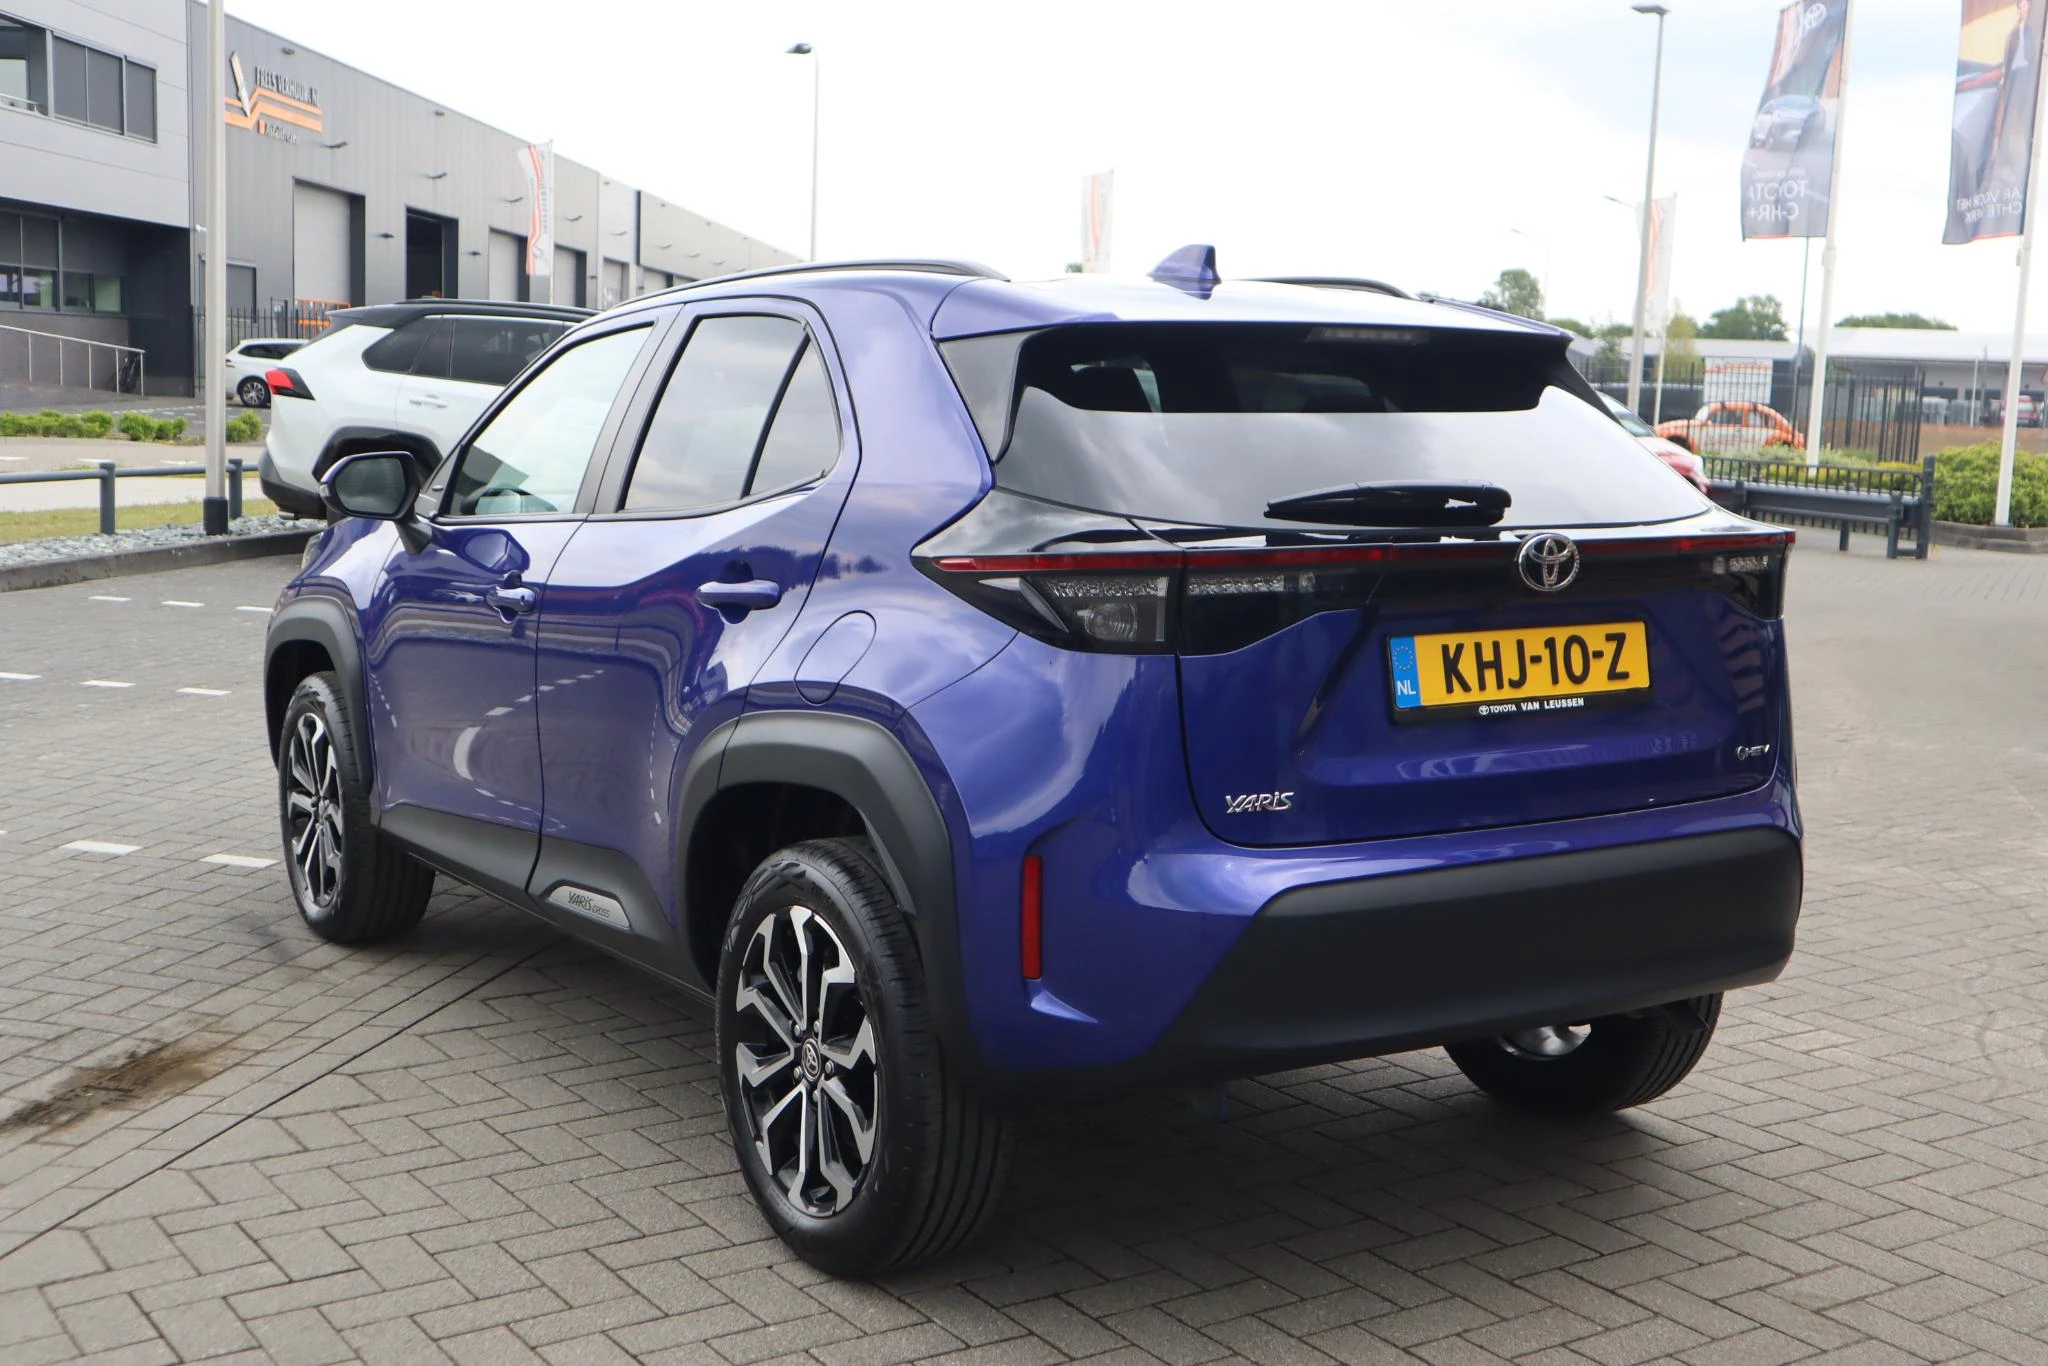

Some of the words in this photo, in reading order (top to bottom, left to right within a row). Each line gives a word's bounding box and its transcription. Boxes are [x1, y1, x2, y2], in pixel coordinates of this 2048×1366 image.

[1441, 632, 1630, 694] KHJ-10-Z
[1397, 680, 1417, 695] NL
[1490, 704, 1518, 713] TOYOTA
[1521, 702, 1540, 711] VAN
[1544, 698, 1584, 710] LEUSSEN
